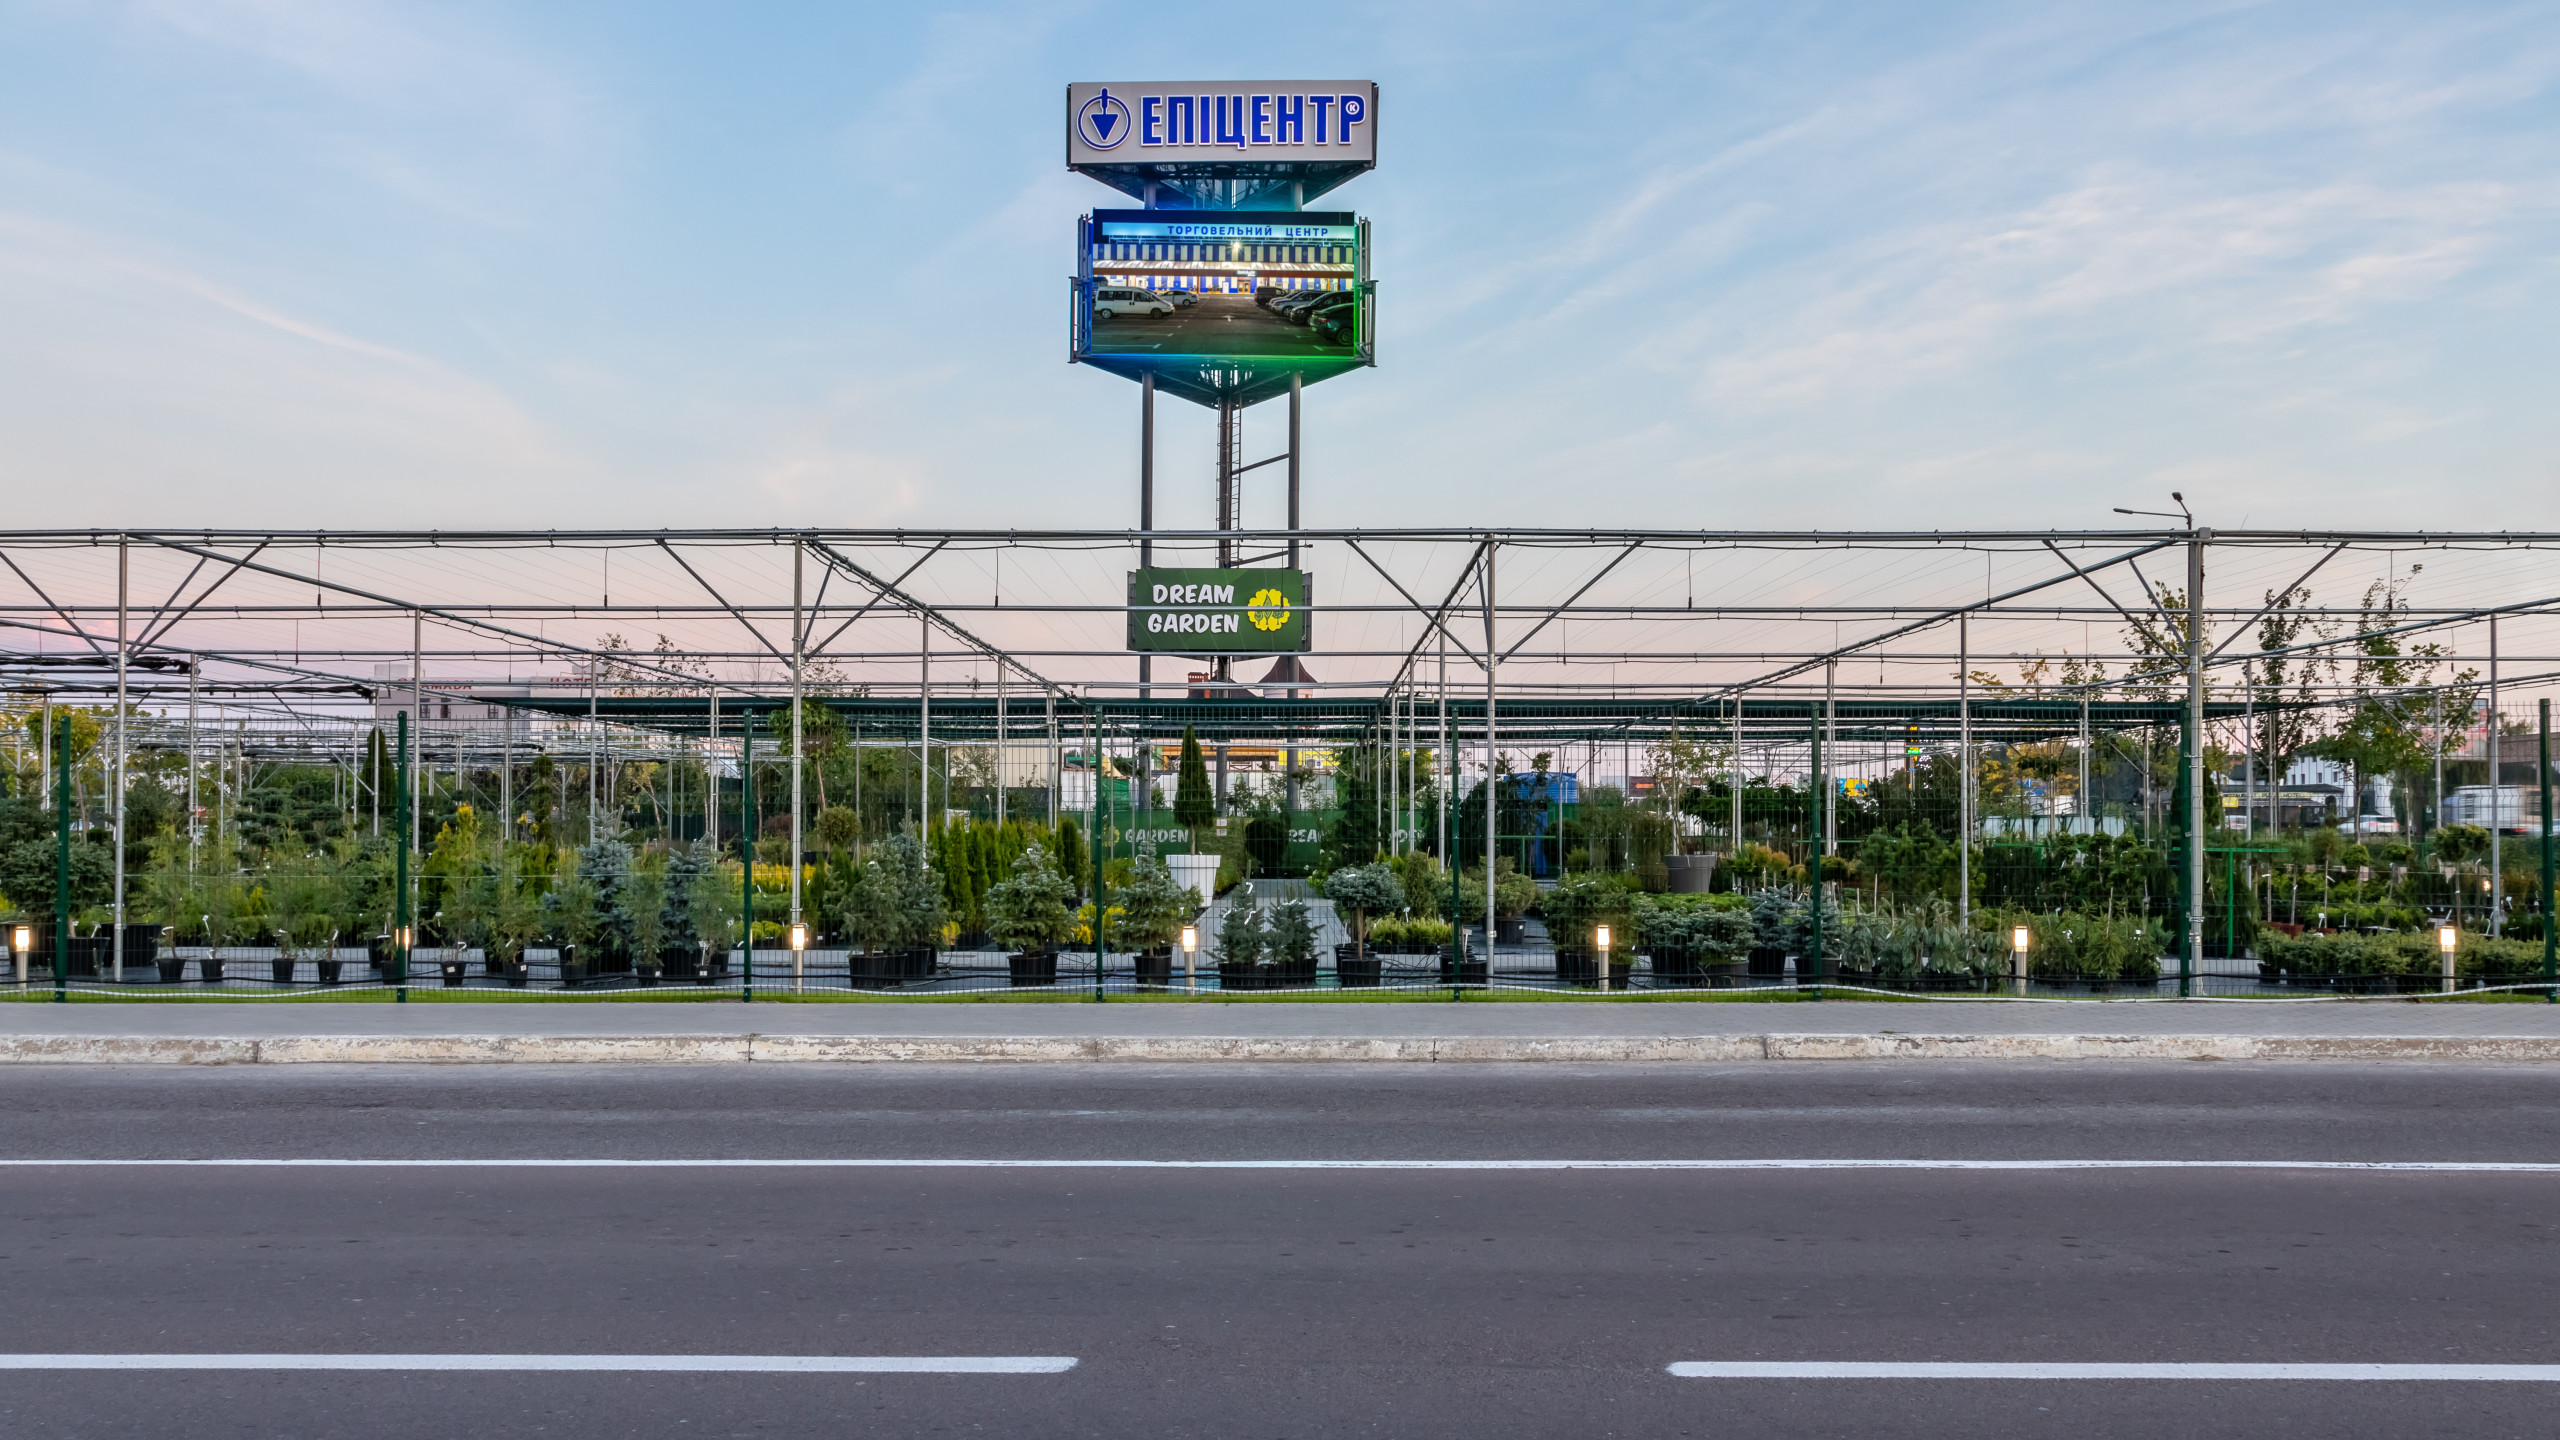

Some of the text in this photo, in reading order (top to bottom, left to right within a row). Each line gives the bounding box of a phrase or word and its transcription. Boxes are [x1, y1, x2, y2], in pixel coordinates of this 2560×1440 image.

[1141, 93, 1366, 150] ЕПІЦЕНТР
[1167, 225, 1329, 238] ТОРГОВЕЛЬНИЙ ЦЕНТР
[1152, 584, 1235, 604] DREAM
[1147, 613, 1240, 633] GARDEN
[411, 678, 473, 690] AMADA
[1125, 829, 1189, 843] GARDEN
